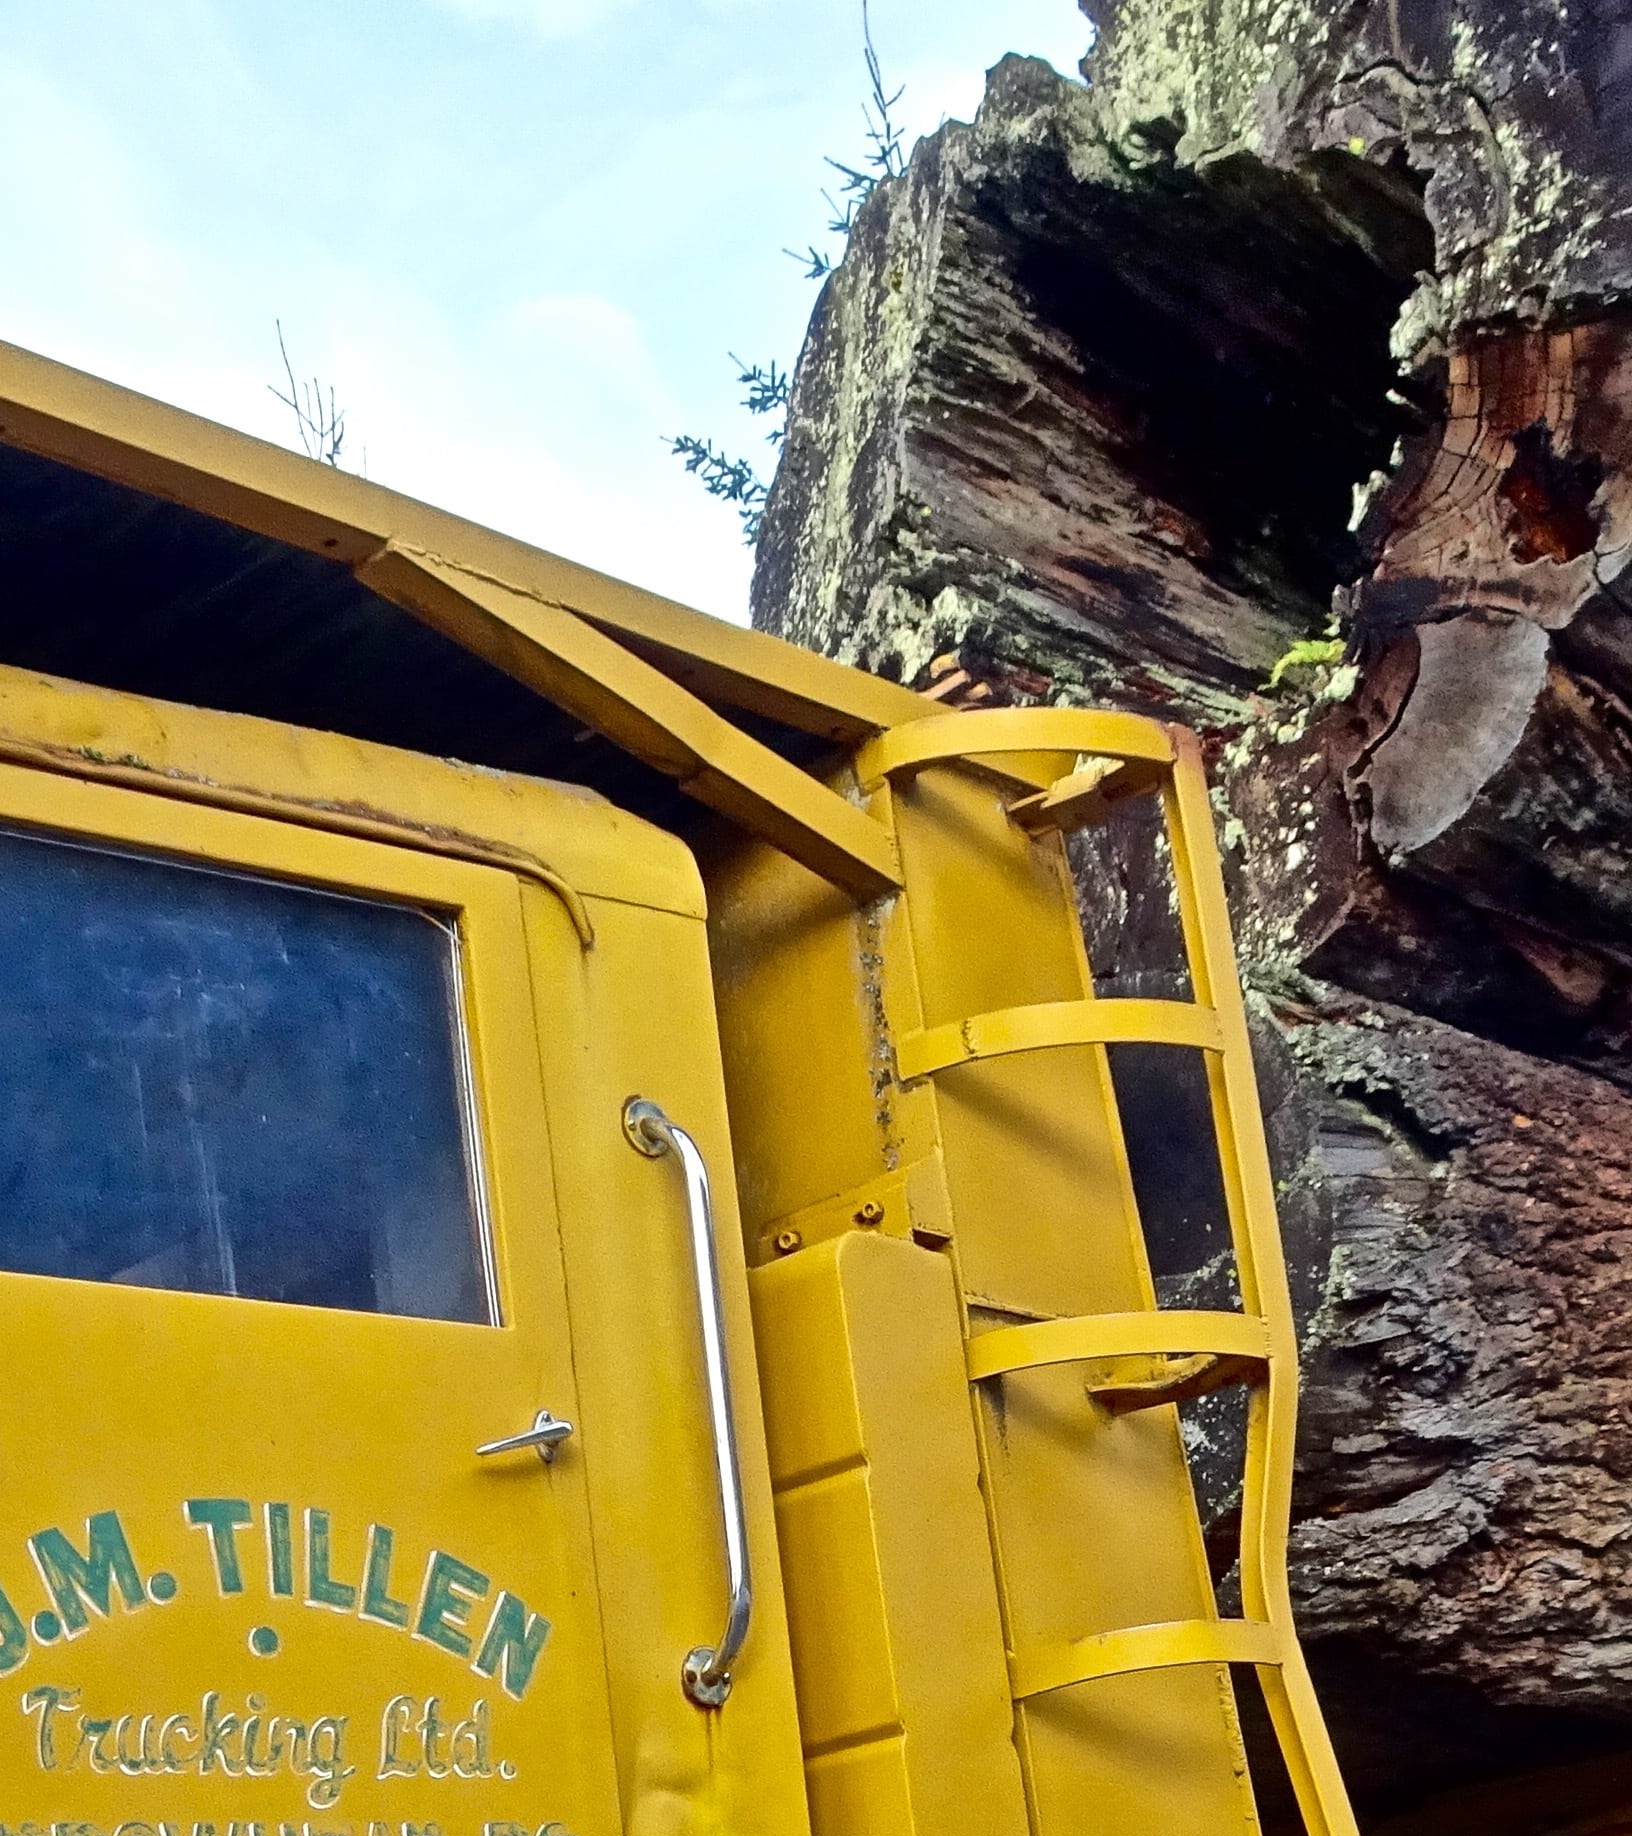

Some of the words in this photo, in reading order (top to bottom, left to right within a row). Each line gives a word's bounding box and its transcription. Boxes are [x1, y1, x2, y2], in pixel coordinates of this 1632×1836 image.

[183, 1497, 552, 1701] TILLEN
[21, 1683, 355, 1809] Trucking
[376, 1694, 518, 1780] Ltd.
